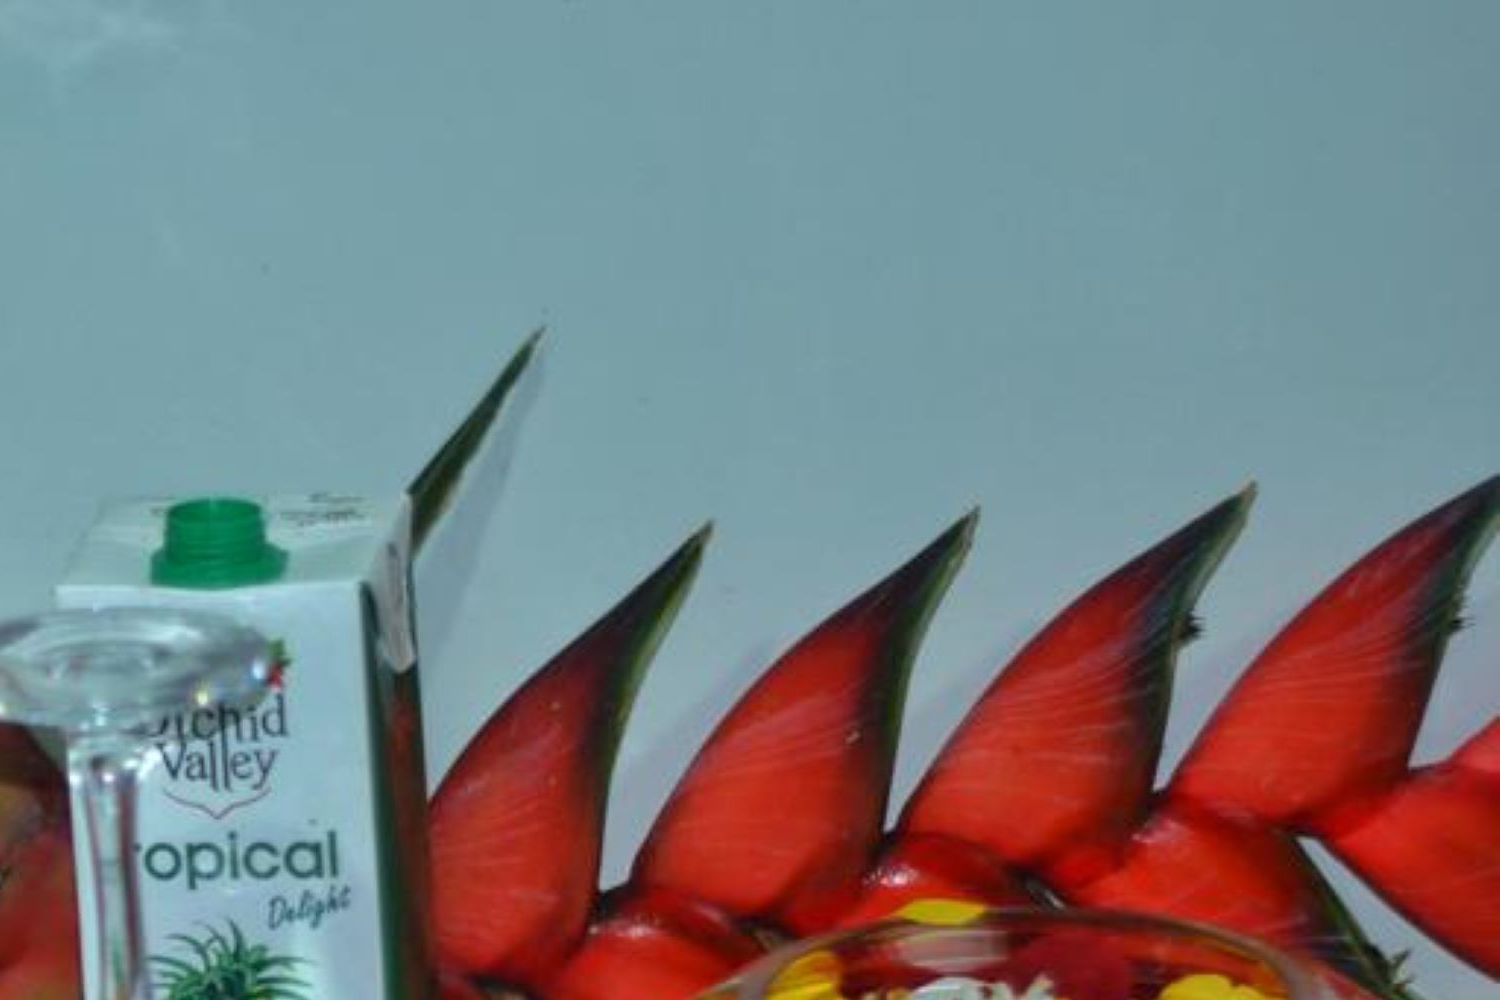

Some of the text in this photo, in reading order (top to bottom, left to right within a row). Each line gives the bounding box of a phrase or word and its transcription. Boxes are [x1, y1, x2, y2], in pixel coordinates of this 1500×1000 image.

[157, 740, 278, 792] Valley
[133, 829, 340, 890] opical
[268, 887, 350, 930] Delight
